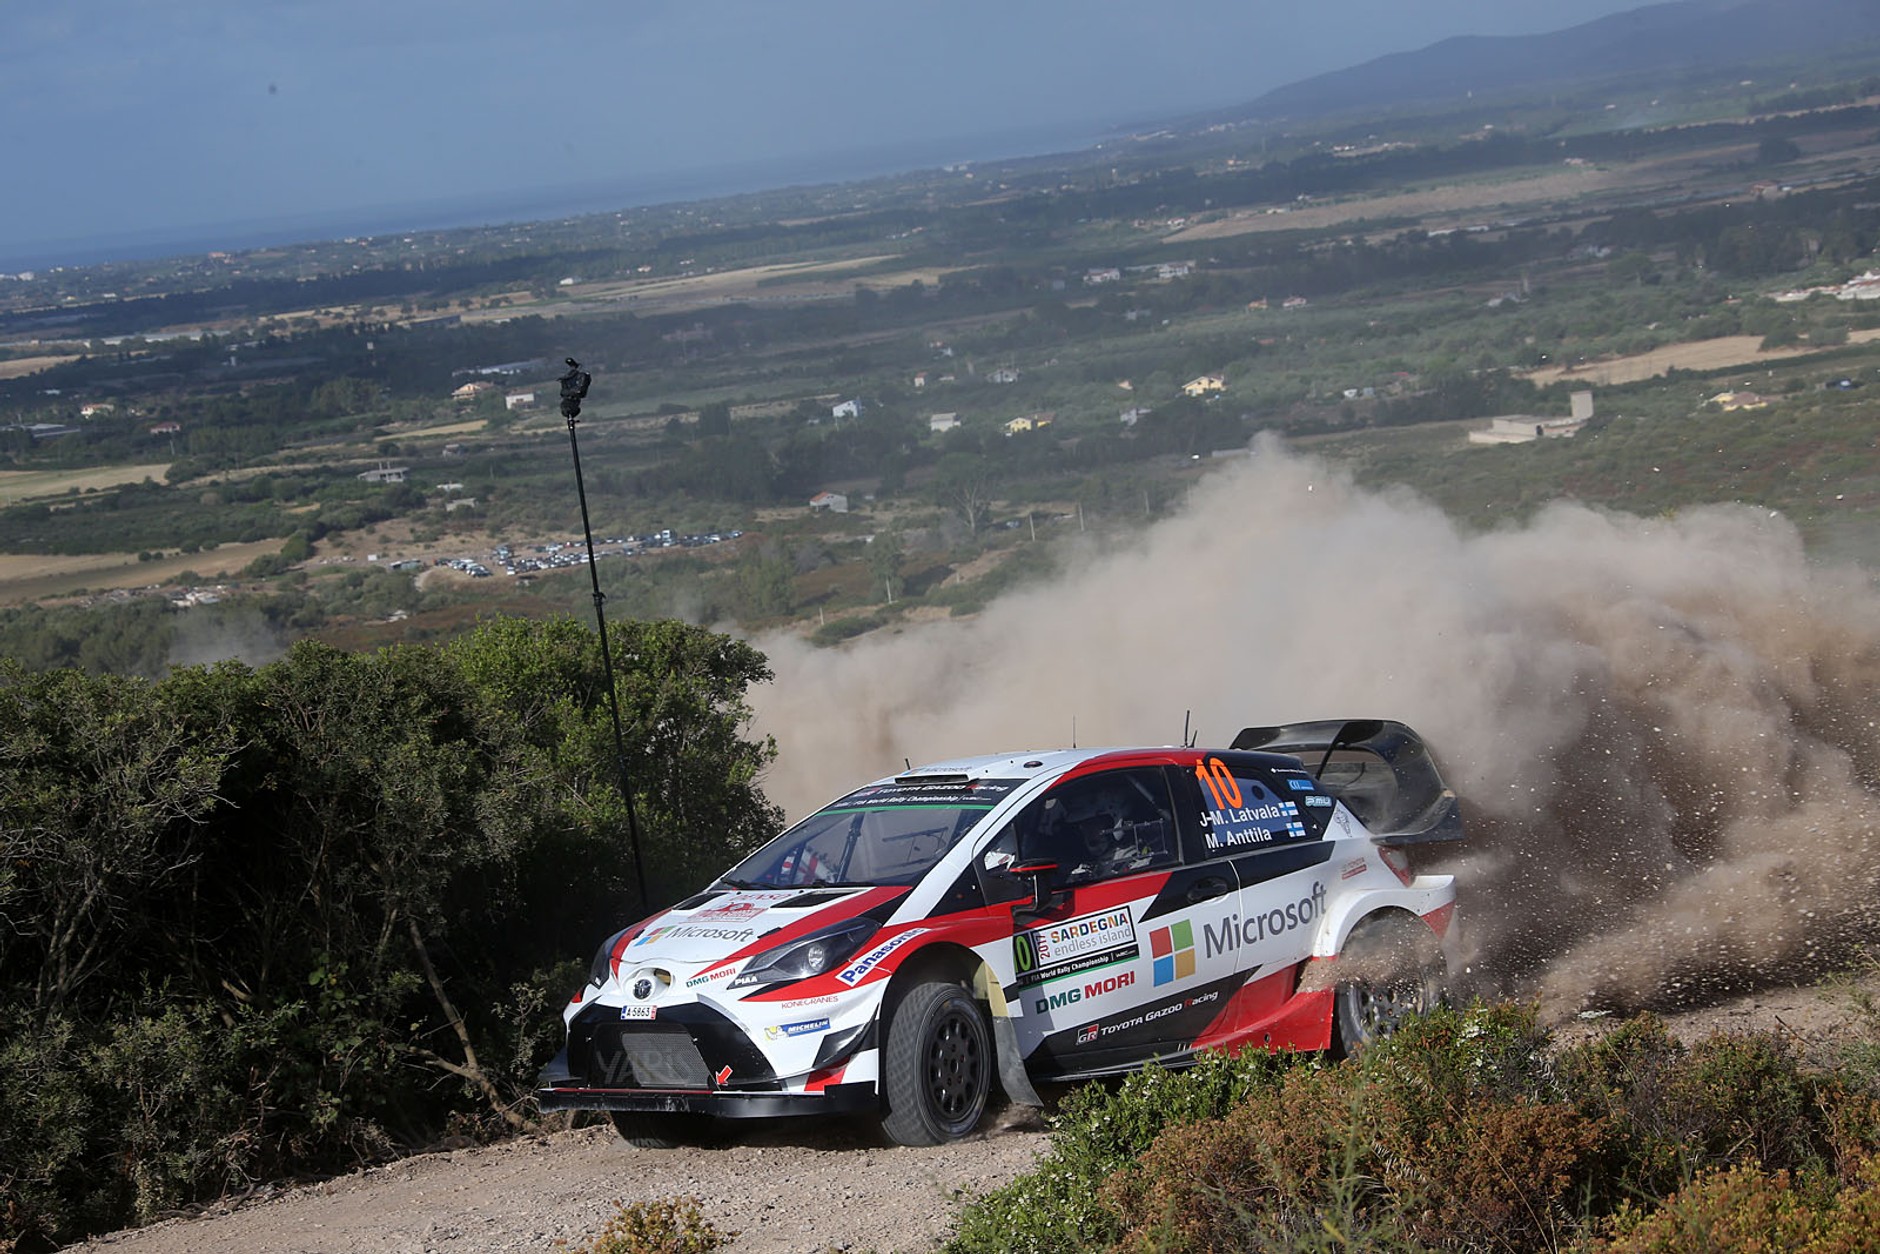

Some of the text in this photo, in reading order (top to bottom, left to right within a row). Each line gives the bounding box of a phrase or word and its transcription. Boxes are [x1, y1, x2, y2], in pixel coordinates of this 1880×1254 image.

[1194, 757, 1243, 810] 10
[1200, 804, 1281, 828] J-M. Latvala
[1205, 827, 1273, 849] M. Anttila
[1051, 913, 1129, 944] SARDEGNA
[1203, 880, 1327, 959] Microsoft
[665, 926, 754, 942] Microsoft
[1054, 937, 1098, 956] endless
[1098, 926, 1132, 944] island
[841, 927, 927, 984] Panasonic
[1038, 935, 1051, 960] 2017
[685, 967, 736, 988] DMG MORI
[1040, 970, 1056, 979] World
[1057, 967, 1071, 975] Rally
[1071, 955, 1110, 970] Championship
[734, 976, 758, 986] PIAA
[1035, 971, 1135, 1014] DMG MORI
[781, 995, 839, 1010] KONECRANES
[1100, 1016, 1143, 1036] TOYOTA
[1145, 1003, 1182, 1022] GAZOO
[1184, 991, 1219, 1009] Racing
[787, 1019, 829, 1034] MICHELIN
